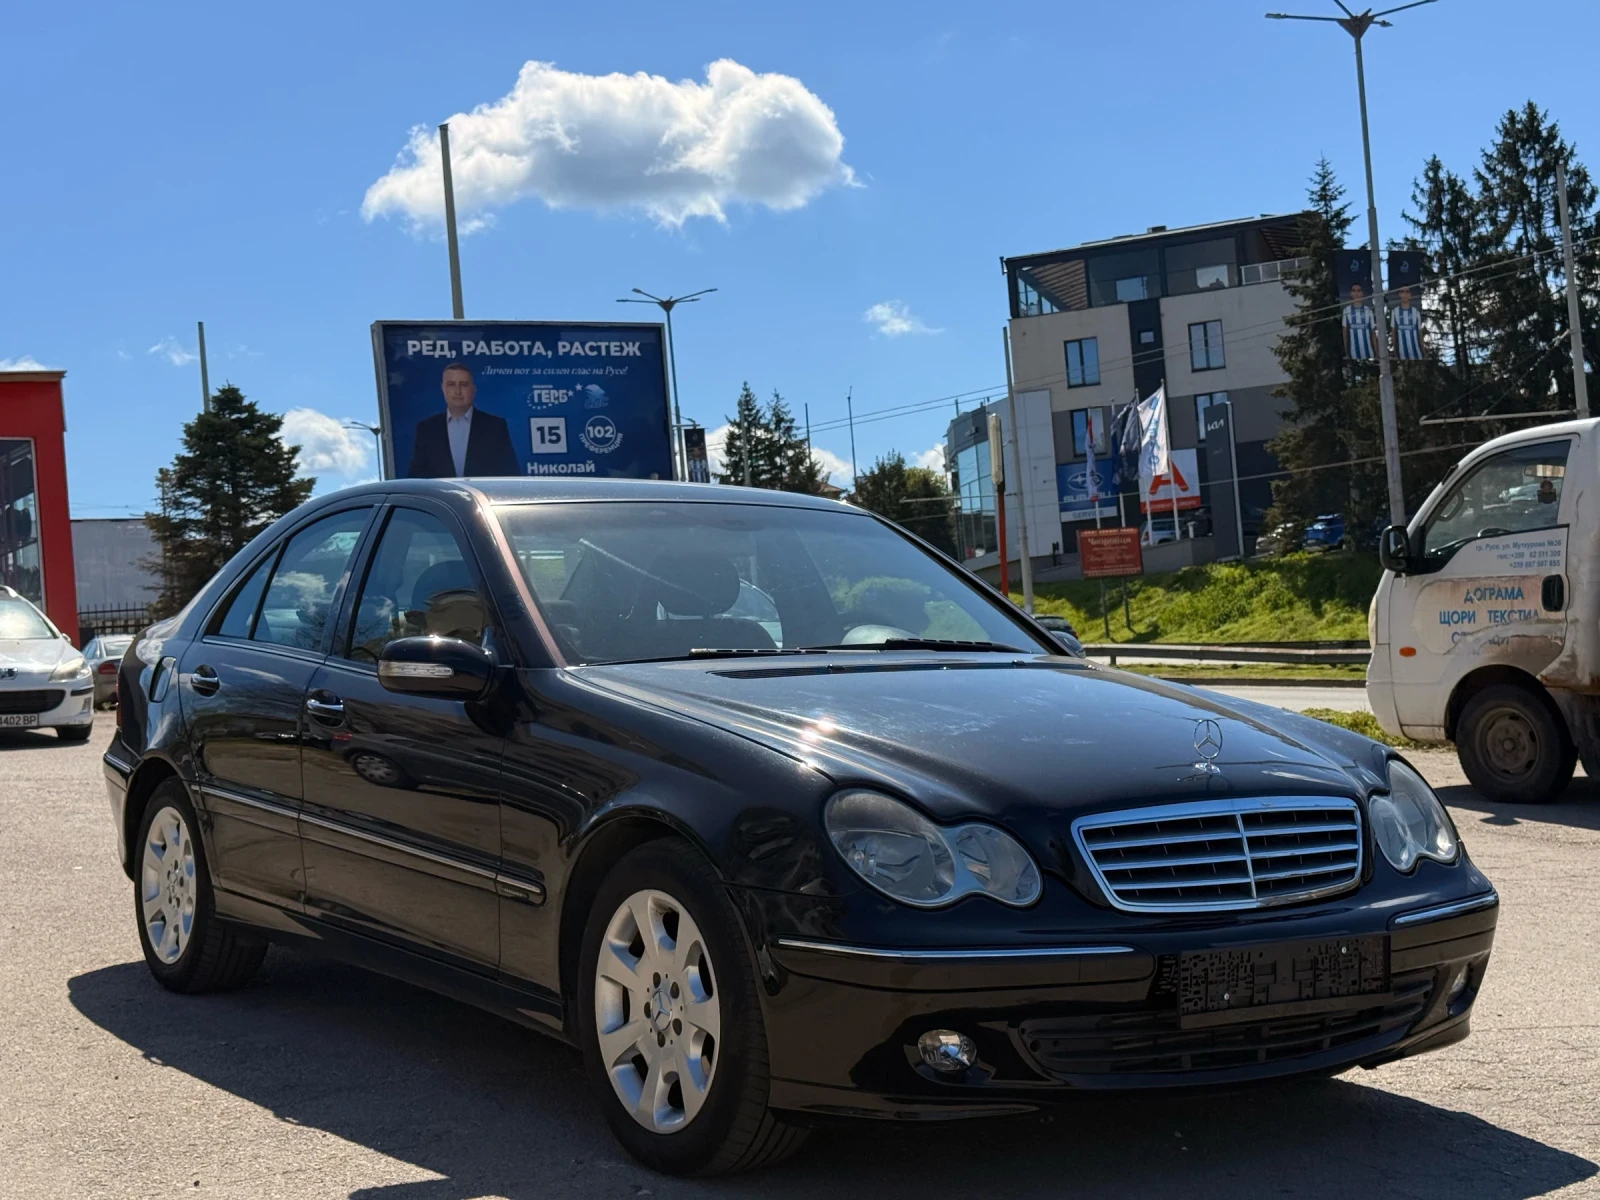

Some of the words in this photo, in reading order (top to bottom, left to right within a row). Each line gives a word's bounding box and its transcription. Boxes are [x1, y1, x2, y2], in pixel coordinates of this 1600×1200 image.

[407, 340, 457, 358] РЕД,
[461, 340, 553, 358] РАБОТА,
[557, 341, 642, 356] РАСТЕЖ
[481, 365, 513, 375] Личен
[605, 366, 629, 377] Русе!
[533, 389, 569, 403] ГЕРБ
[536, 426, 562, 444] 15
[587, 426, 614, 438] 102
[579, 432, 624, 454] ПРЕФЕРЕНЦИЯ
[527, 460, 596, 474] Николай
[1464, 587, 1524, 604] ДОГРАМА
[1440, 610, 1476, 626] ЩОРИ
[23, 715, 36, 725] BP
